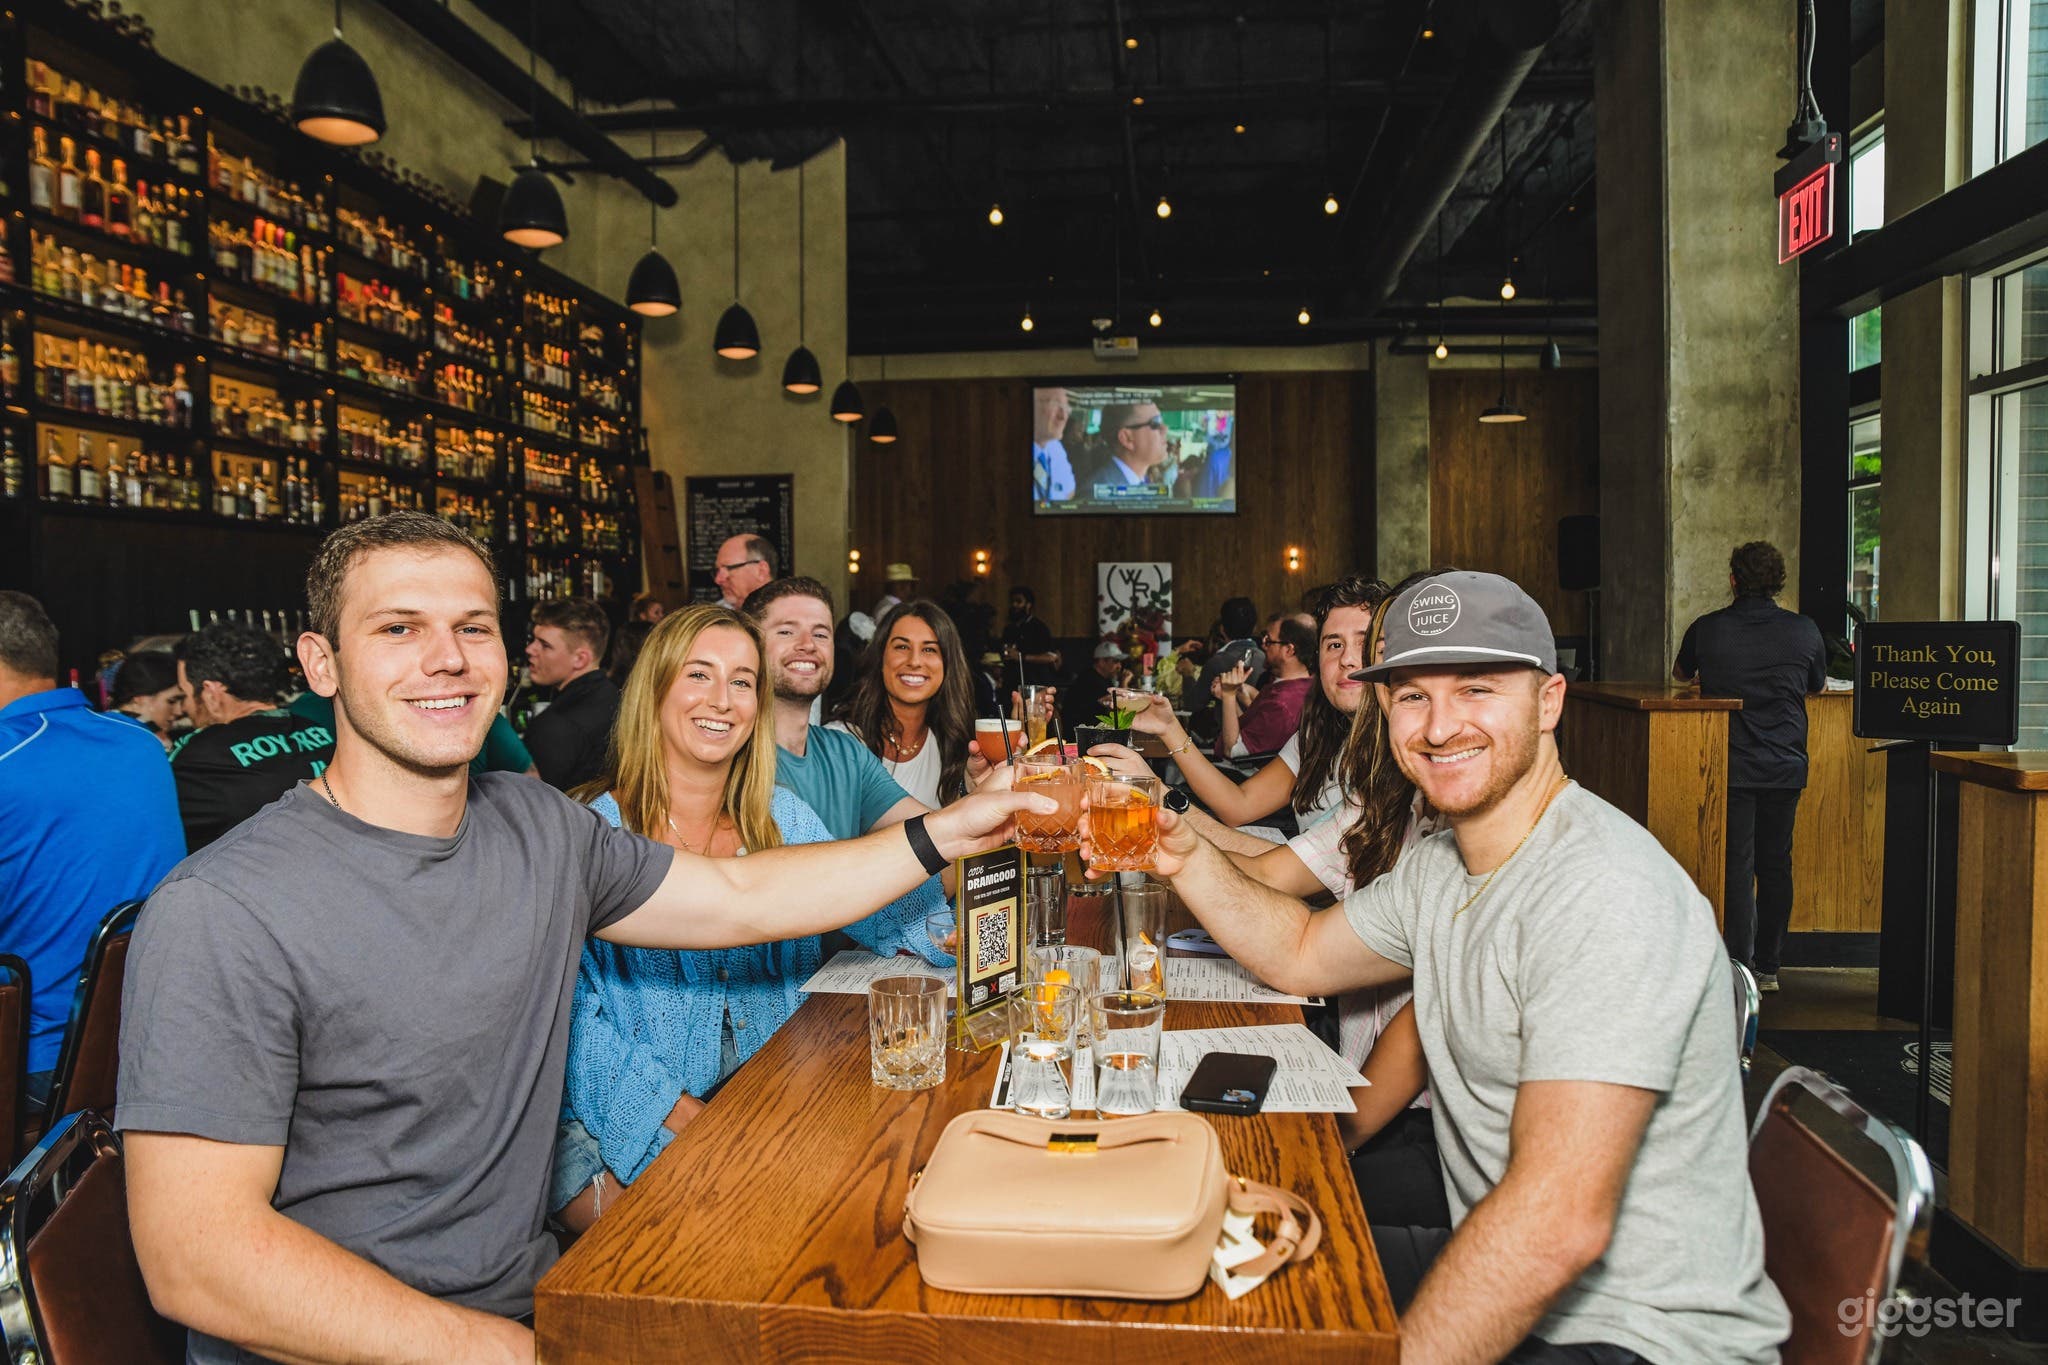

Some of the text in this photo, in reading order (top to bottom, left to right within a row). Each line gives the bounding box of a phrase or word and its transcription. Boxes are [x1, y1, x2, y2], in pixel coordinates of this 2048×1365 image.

[1789, 175, 1825, 253] EXIT
[1413, 594, 1455, 609] SWING
[1415, 613, 1449, 627] JUICE
[1872, 645, 1996, 667] Thank You,
[1870, 671, 2000, 691] Please Come
[1901, 696, 1962, 719] Again
[230, 734, 292, 768] ROY
[967, 868, 1016, 892] DRAMGOOD
